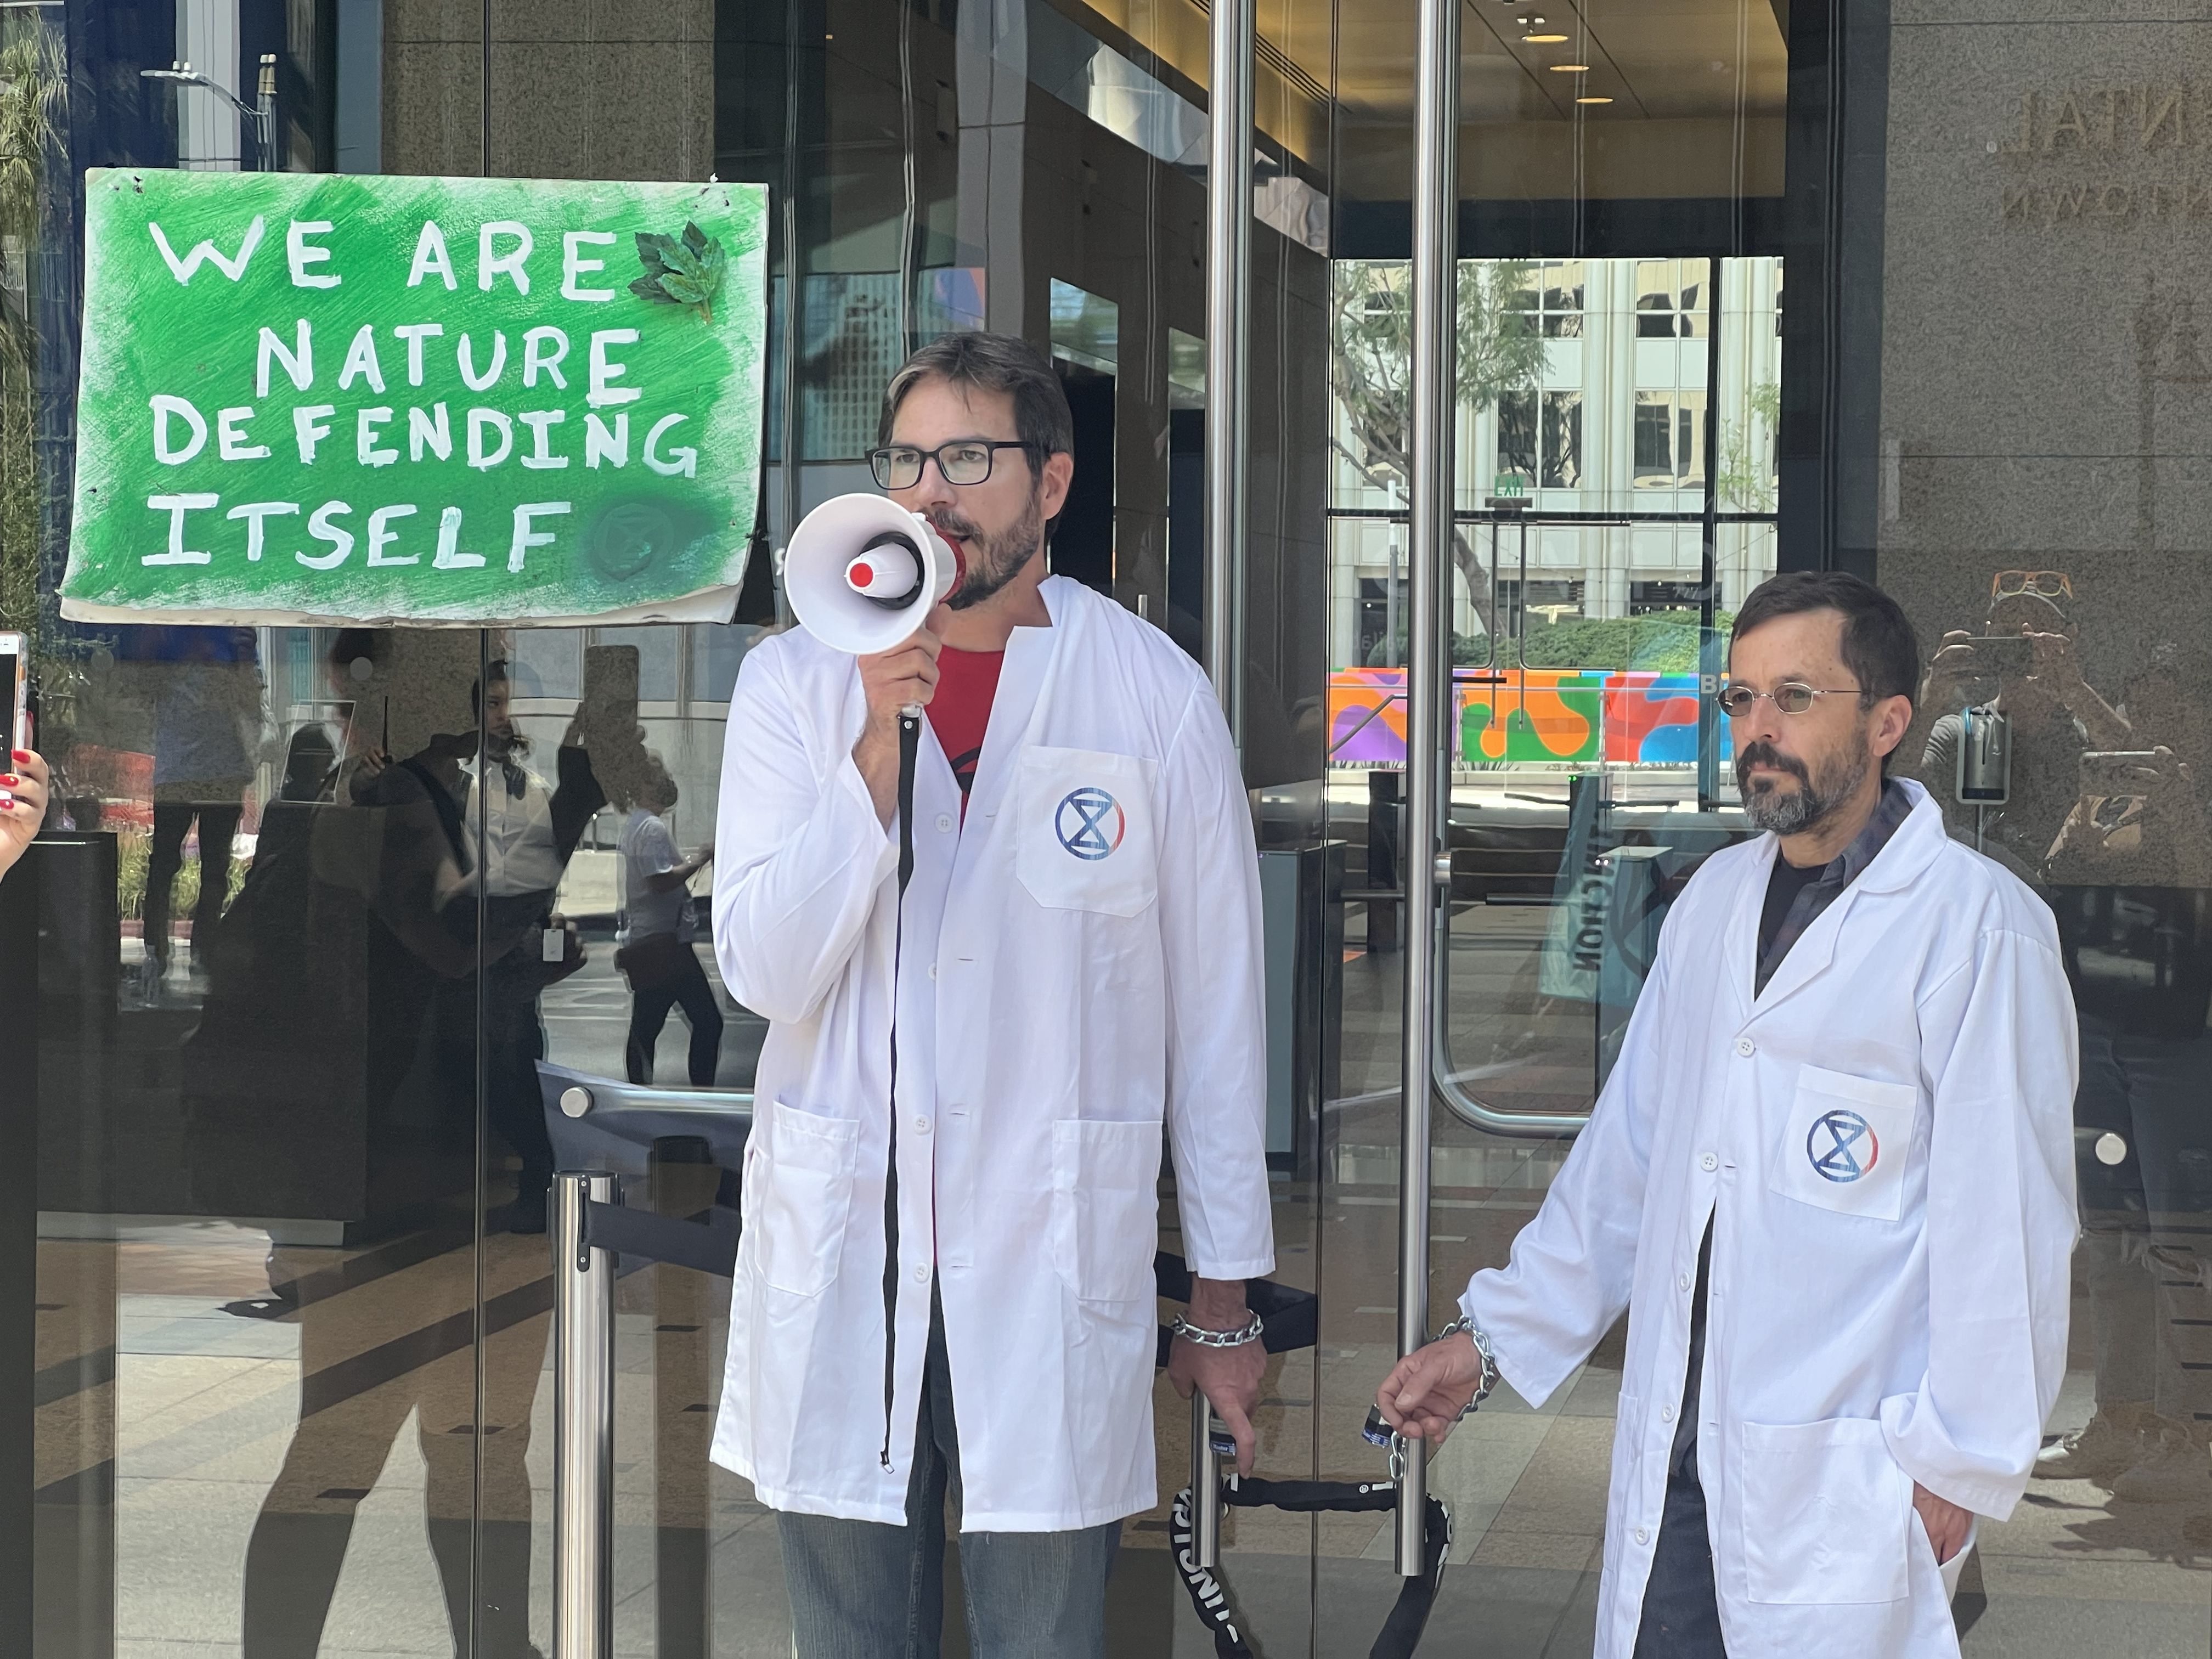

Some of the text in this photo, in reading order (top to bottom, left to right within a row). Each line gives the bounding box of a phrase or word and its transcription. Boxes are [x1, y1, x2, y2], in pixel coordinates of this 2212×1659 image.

[148, 215, 617, 302] WE ARE
[255, 318, 643, 409] NATURE
[149, 394, 698, 478] DEFENDING
[1494, 473, 1525, 497] EXIT
[140, 492, 572, 573] ITSELF
